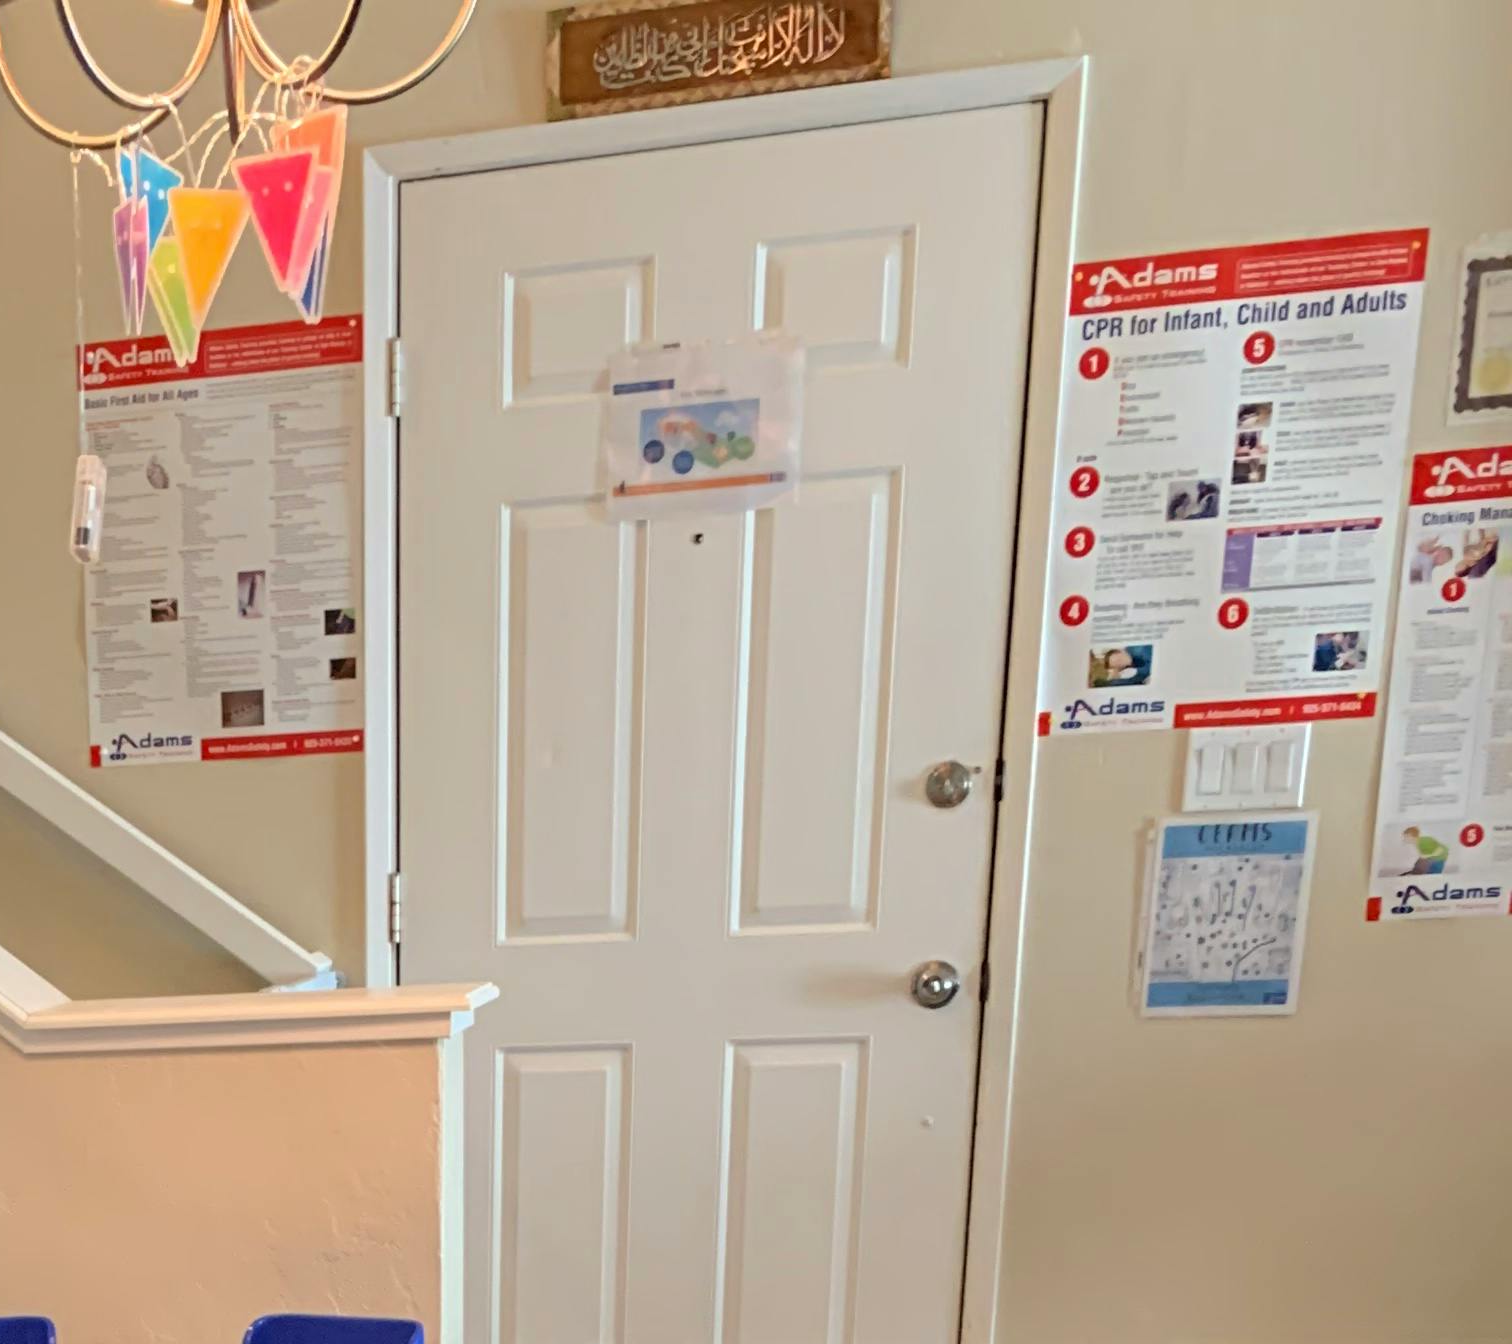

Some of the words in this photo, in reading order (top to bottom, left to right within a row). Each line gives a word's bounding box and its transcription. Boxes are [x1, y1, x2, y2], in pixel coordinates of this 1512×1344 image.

[1090, 261, 1219, 296] Adams
[1081, 317, 1124, 341] CPR
[1130, 315, 1158, 336] for
[1164, 306, 1228, 333] Infant,
[1238, 300, 1291, 325] Child
[1296, 295, 1336, 320] and
[1340, 289, 1408, 315] Adults
[90, 343, 178, 373] Adam
[1252, 337, 1266, 358] 5
[1088, 354, 1099, 372] 1
[1078, 473, 1091, 492] 2
[1422, 511, 1476, 527] Choking
[1073, 533, 1086, 551] 3
[1449, 582, 1458, 598] 1
[1067, 601, 1081, 620] 4
[1226, 603, 1240, 624] 6
[1064, 698, 1166, 721] Adams
[115, 732, 194, 753] Adams
[1396, 883, 1503, 905] Adams
